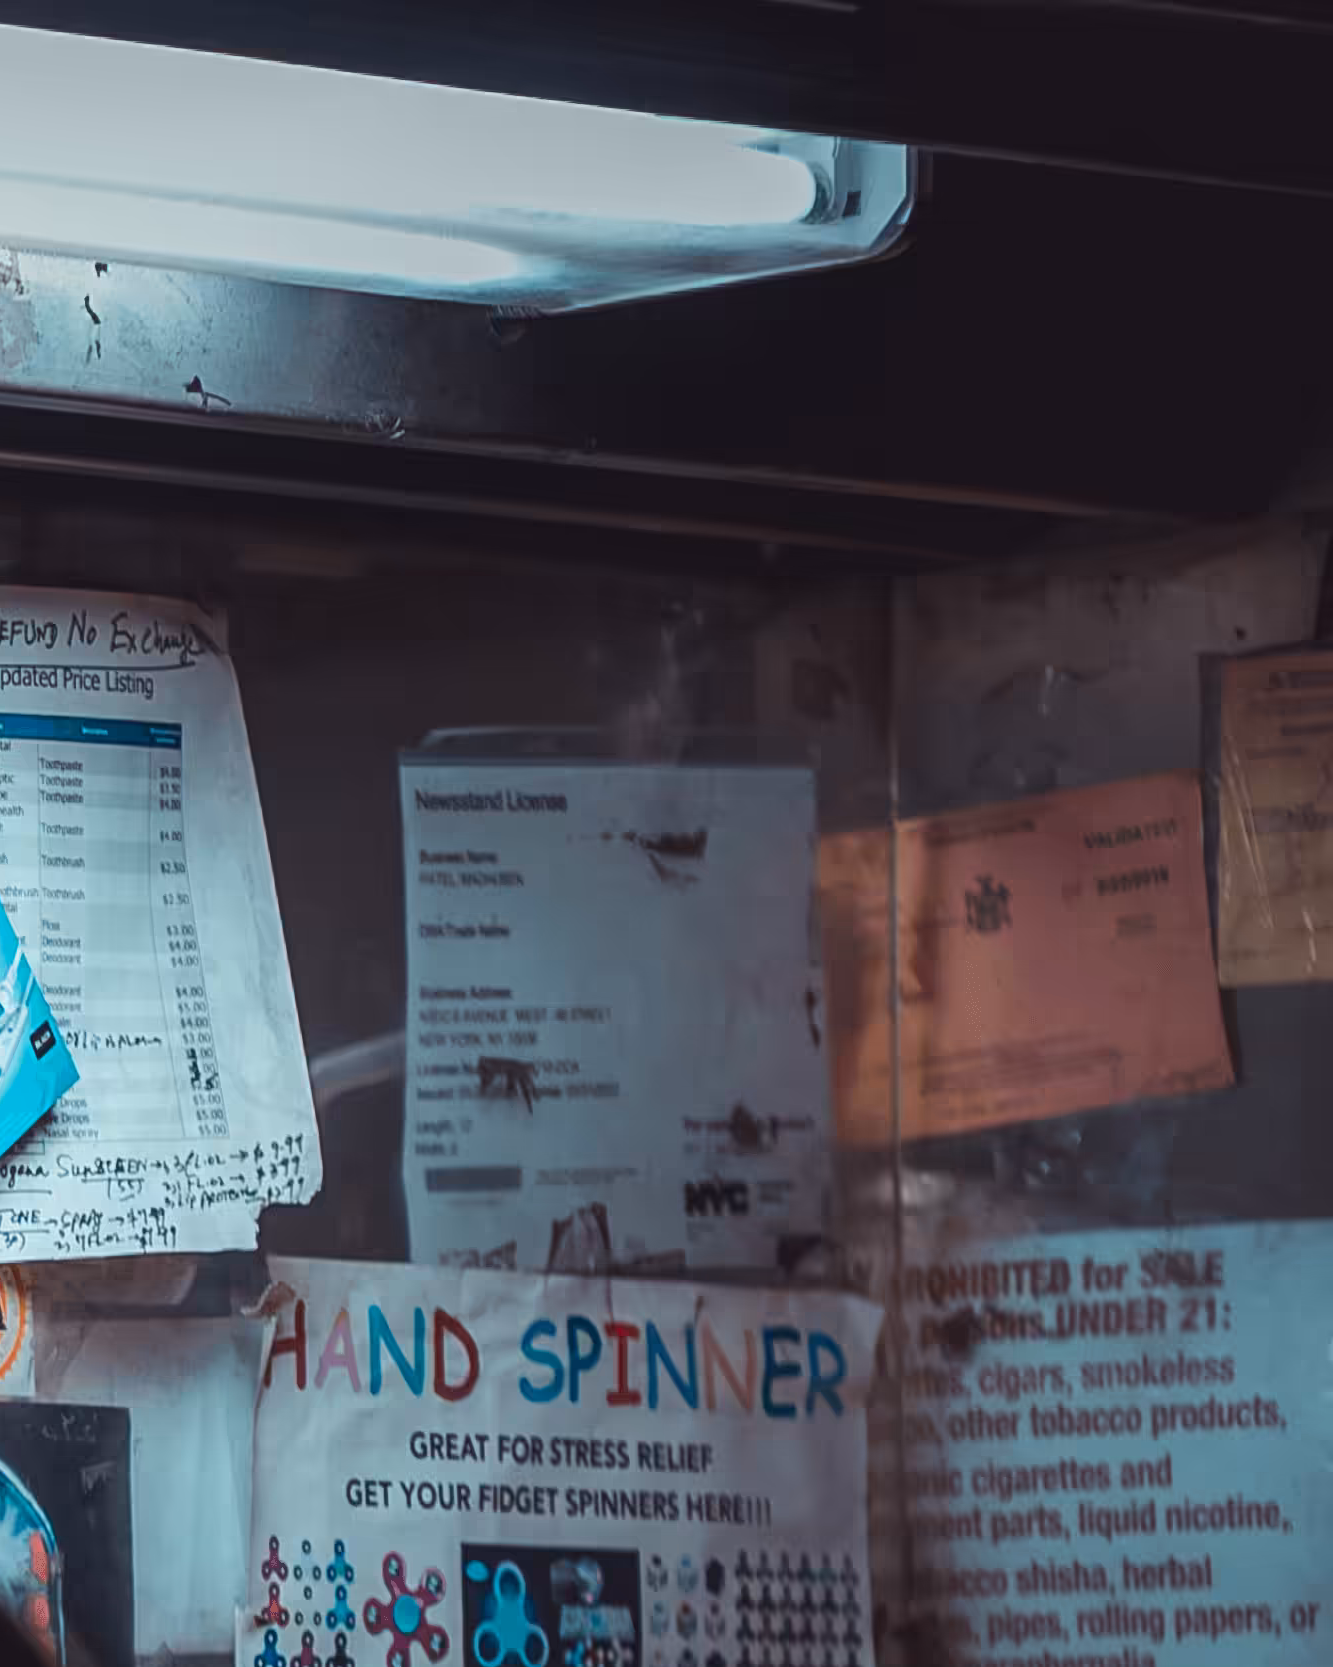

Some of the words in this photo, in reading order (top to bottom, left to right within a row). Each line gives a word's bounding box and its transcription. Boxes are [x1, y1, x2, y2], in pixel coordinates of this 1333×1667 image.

[64, 667, 101, 692] Price
[106, 672, 154, 700] Listing
[40, 758, 83, 772] Toothpaste
[40, 774, 83, 788] Toothpaste
[40, 790, 83, 805] Toothpaste
[41, 822, 84, 837] Toothpaste
[1083, 1256, 1130, 1294] for
[1057, 1297, 1168, 1340] UNDER
[262, 1297, 481, 1404] HAND
[517, 1314, 847, 1419] SPINNER
[978, 1361, 1073, 1401] cigars,
[1081, 1351, 1236, 1389] smokeless
[948, 1406, 1020, 1441] other
[1030, 1400, 1141, 1439] tobacco
[1150, 1393, 1286, 1440] products,
[409, 1430, 488, 1463] GREAT
[497, 1433, 542, 1466] FOR
[550, 1436, 630, 1471] STRESS
[638, 1441, 714, 1474] RELIEF
[971, 1455, 1111, 1499] cigarettes
[1119, 1450, 1172, 1490] and
[344, 1478, 392, 1510] GET
[400, 1480, 471, 1512] YOUR
[478, 1483, 558, 1516] FIDGET
[565, 1486, 681, 1522] SPINNERS
[991, 1506, 1071, 1545] parts,
[1078, 1501, 1157, 1544] liquid
[1016, 1558, 1117, 1598] shisha,
[1122, 1552, 1214, 1590] herbal
[986, 1606, 1071, 1647] pipes,
[1077, 1603, 1165, 1645] rolling
[1174, 1603, 1282, 1643] papers,
[1289, 1602, 1321, 1633] or
